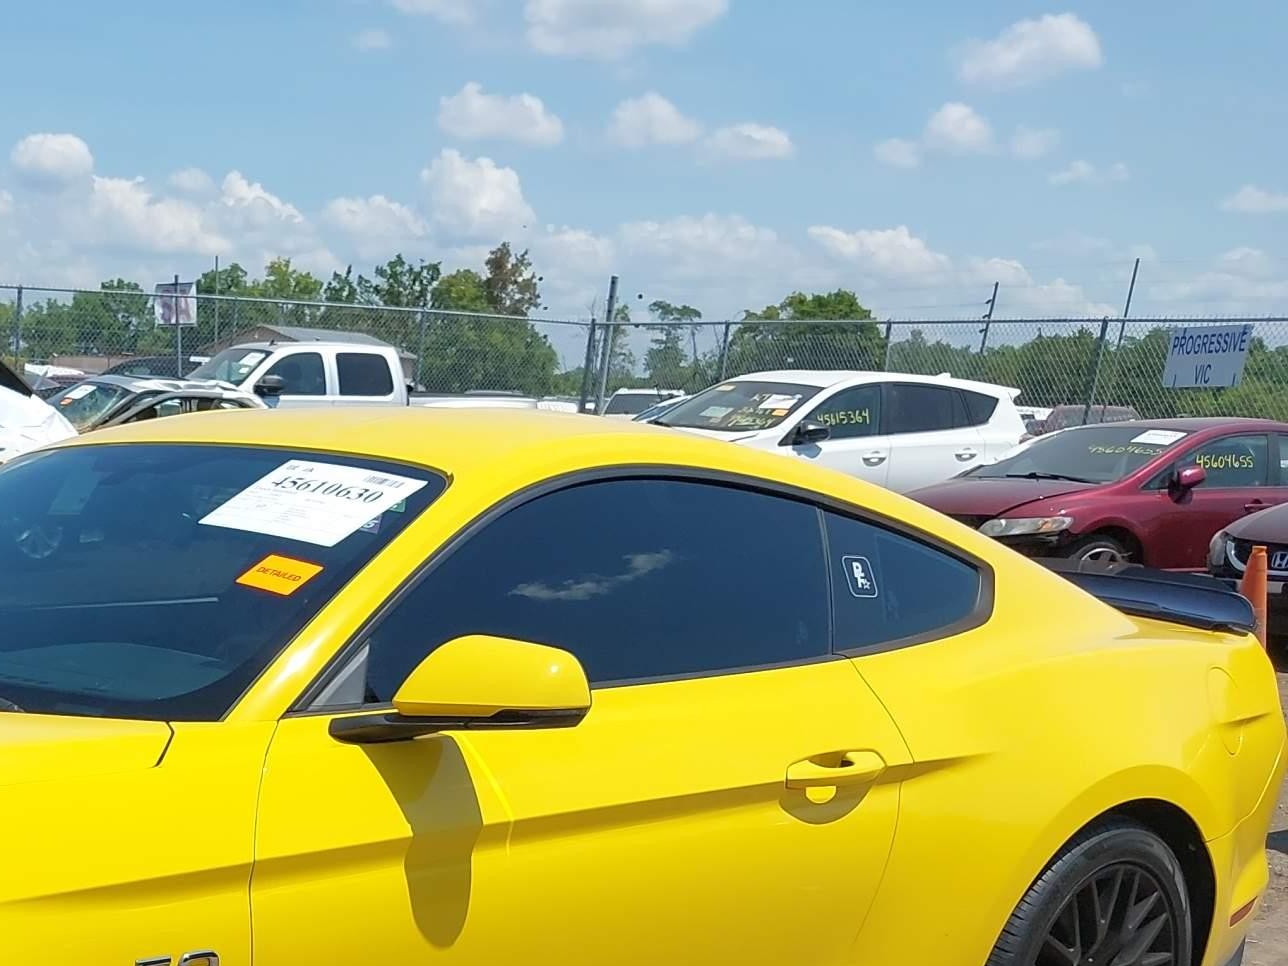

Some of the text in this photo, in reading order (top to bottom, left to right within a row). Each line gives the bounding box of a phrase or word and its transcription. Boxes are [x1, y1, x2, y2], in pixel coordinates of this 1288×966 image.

[1172, 329, 1248, 356] PROGRESSIVE
[1194, 364, 1212, 384] VIC
[816, 408, 870, 426] 45615364
[1196, 454, 1253, 469] 45604655
[272, 476, 384, 504] 45610630
[256, 566, 302, 582] DETAILED
